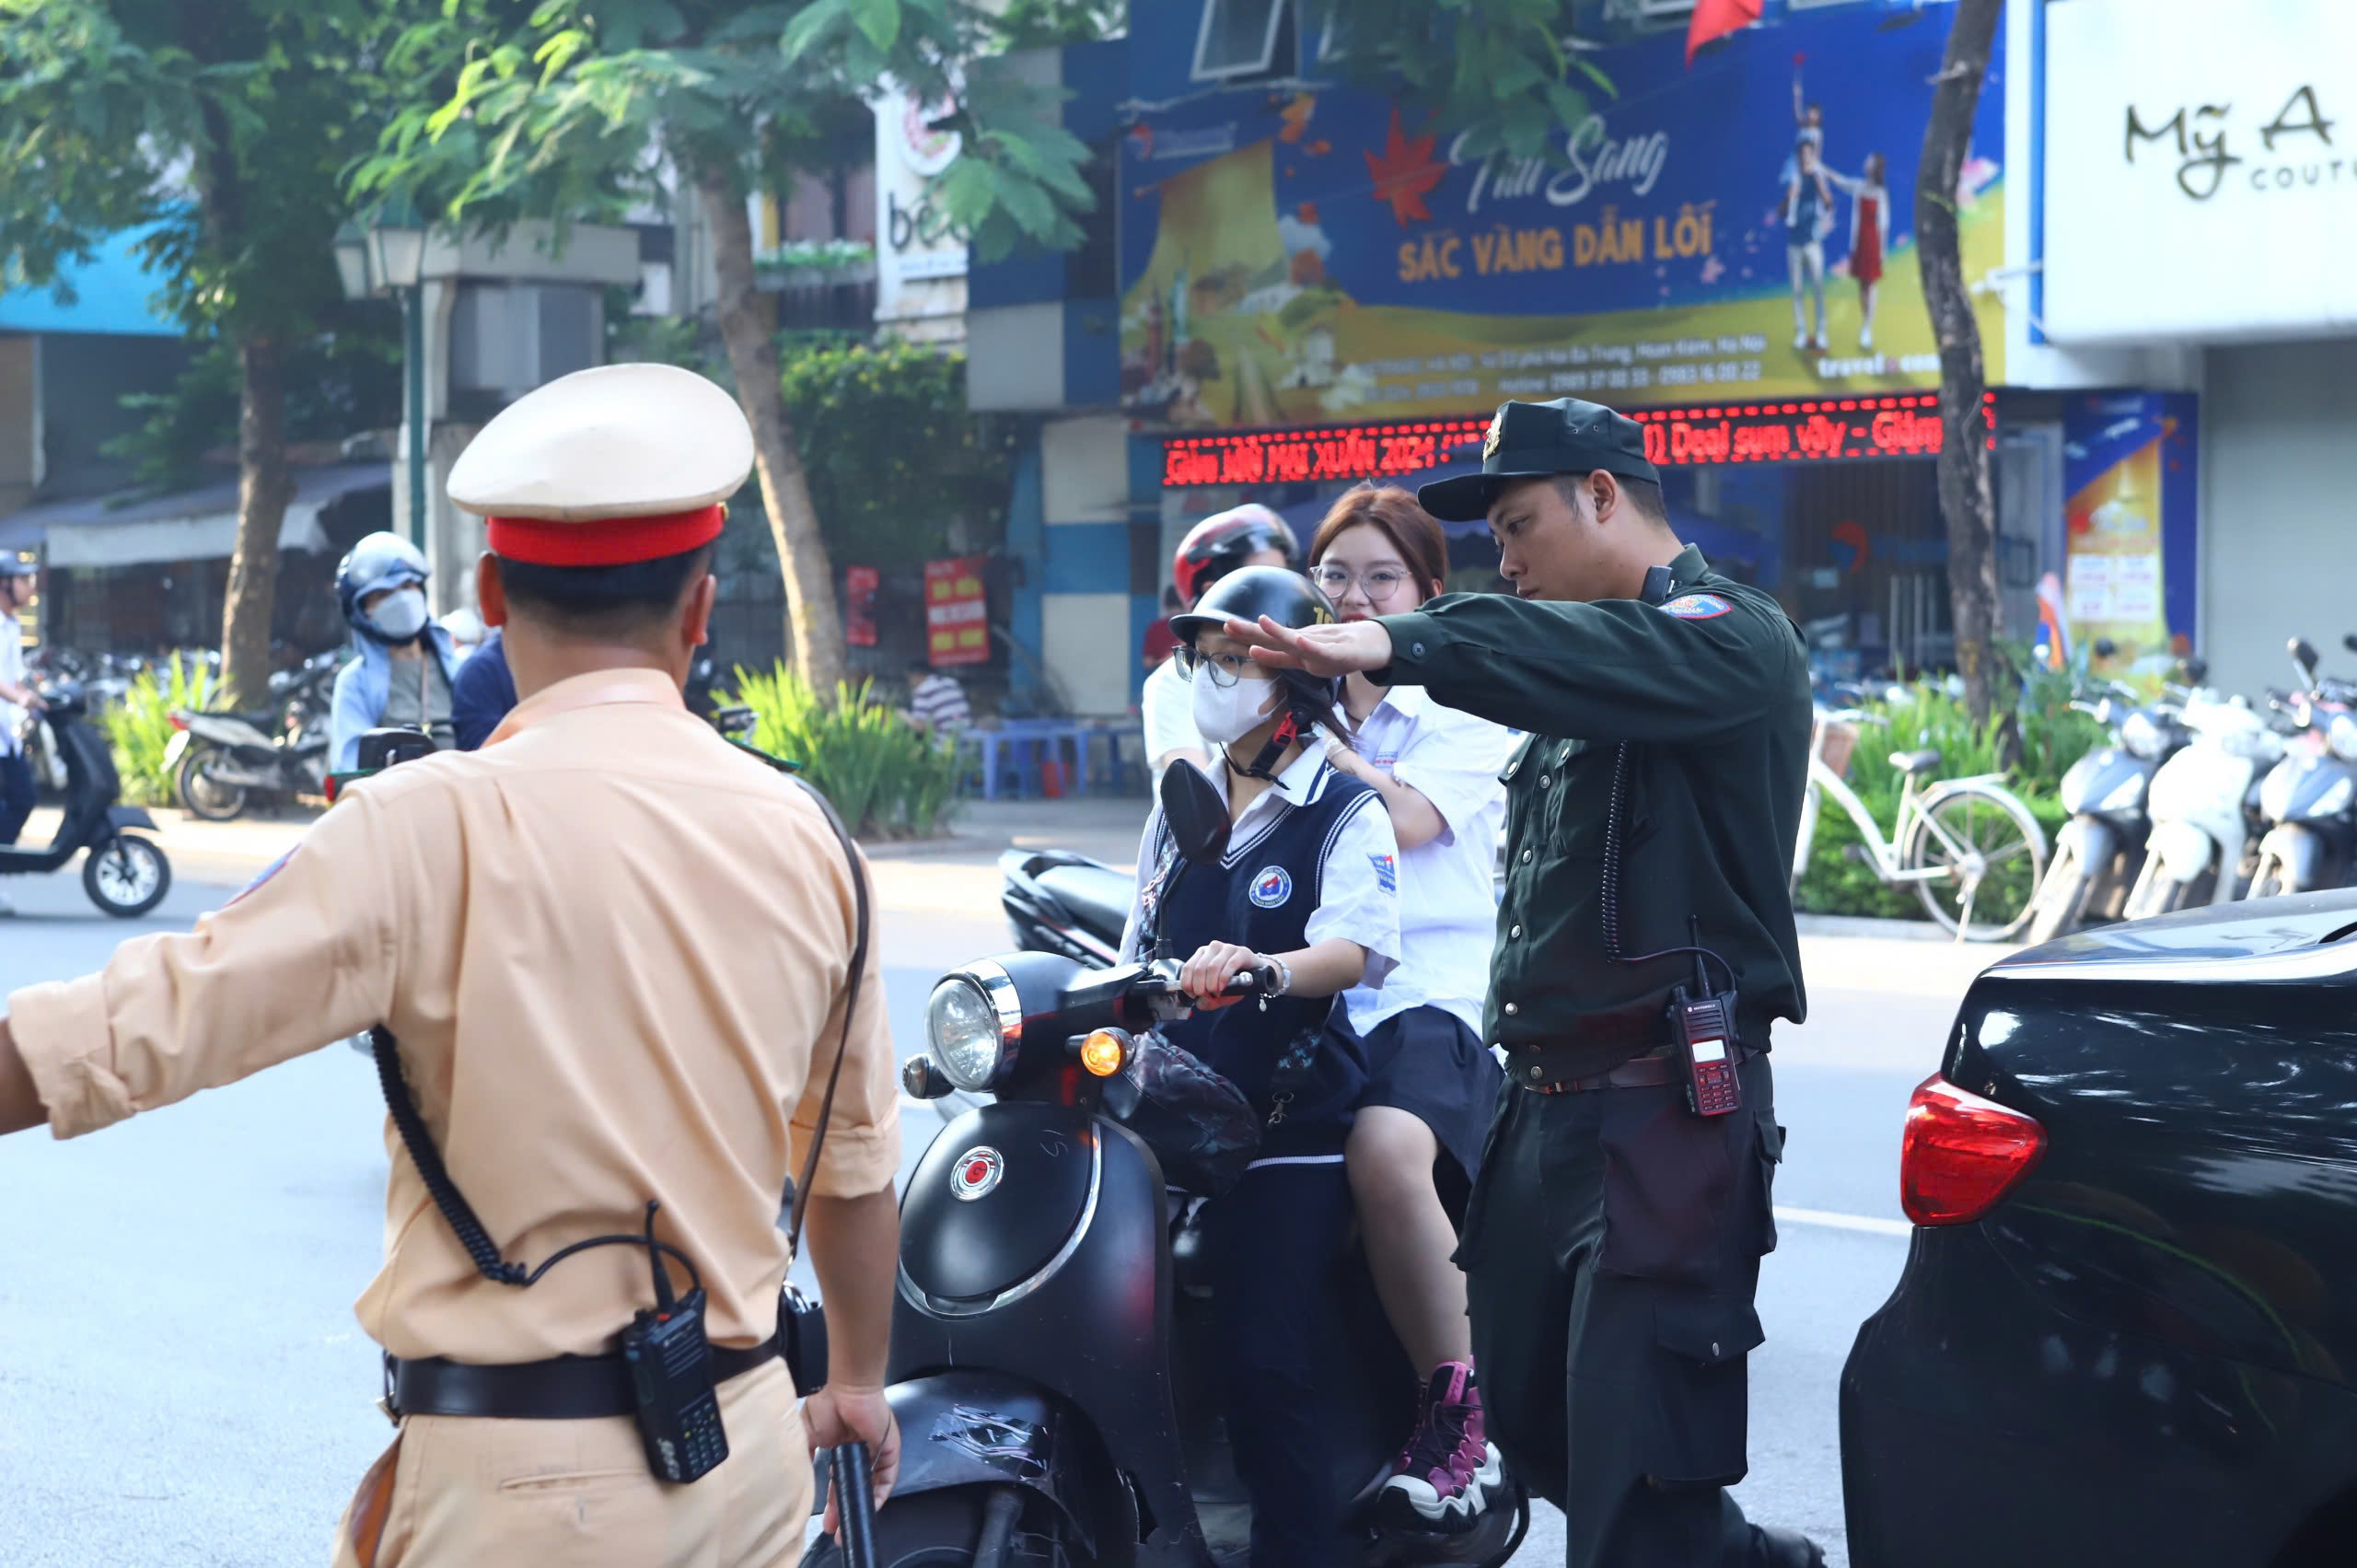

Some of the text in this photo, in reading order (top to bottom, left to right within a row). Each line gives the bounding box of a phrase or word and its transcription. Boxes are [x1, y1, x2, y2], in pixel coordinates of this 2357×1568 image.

[1546, 113, 1668, 205] Sang
[2124, 85, 2336, 202] Mỹ A
[2250, 159, 2357, 190] COUT
[1472, 223, 1563, 274] VÀNG
[1671, 421, 1729, 458] Deal
